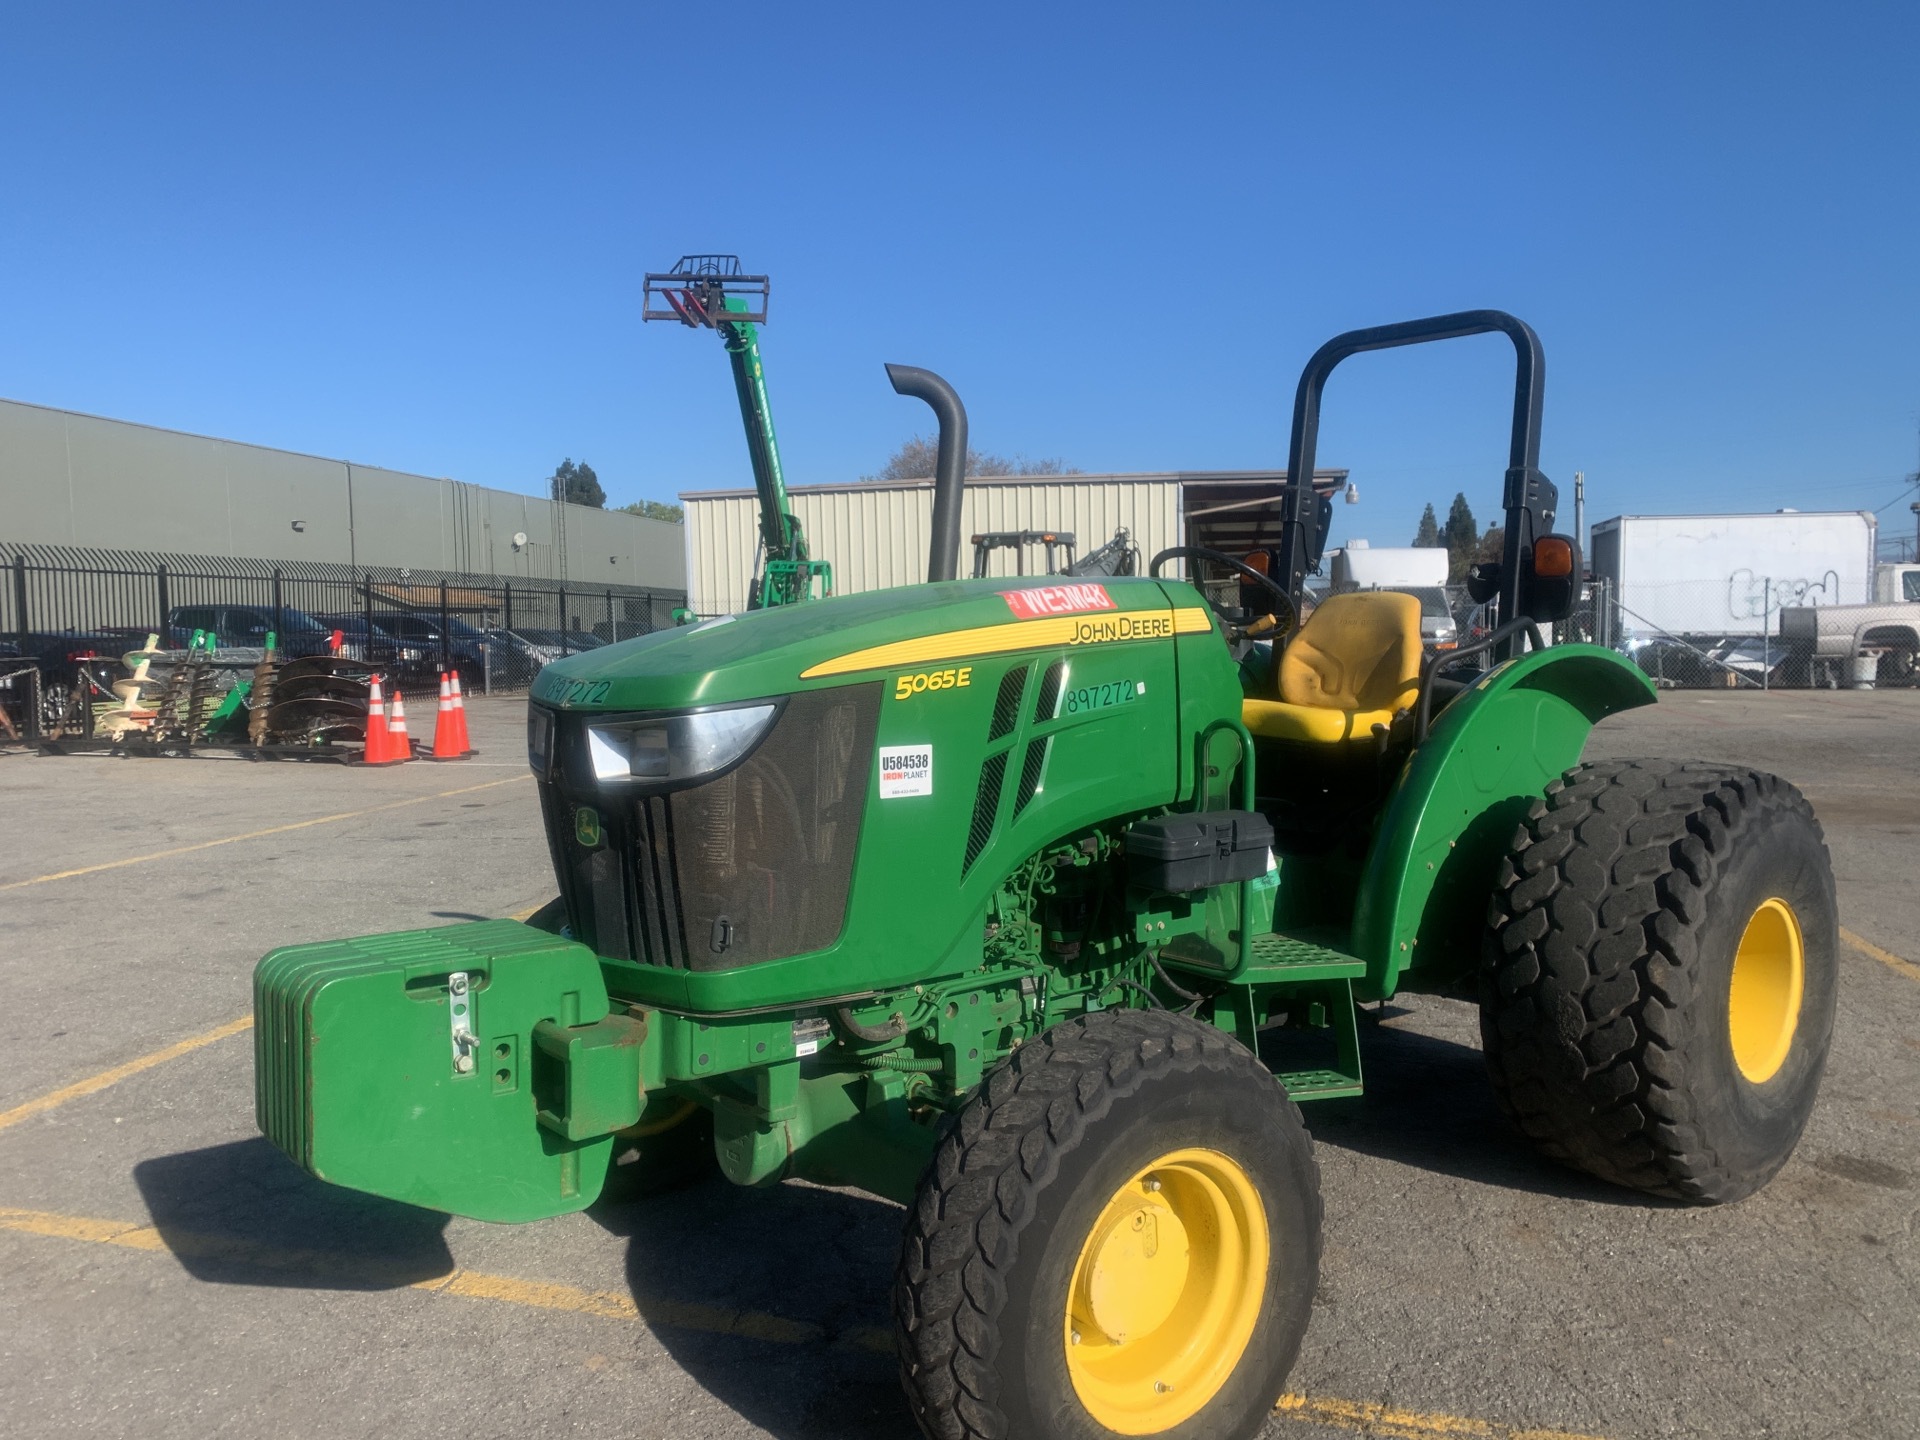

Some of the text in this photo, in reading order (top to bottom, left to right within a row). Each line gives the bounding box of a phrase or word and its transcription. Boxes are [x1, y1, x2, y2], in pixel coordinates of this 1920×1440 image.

[1070, 617, 1171, 642] JOHN DEERE
[895, 667, 972, 700] 5065E
[1067, 679, 1134, 713] 897272
[882, 754, 928, 770] U584538
